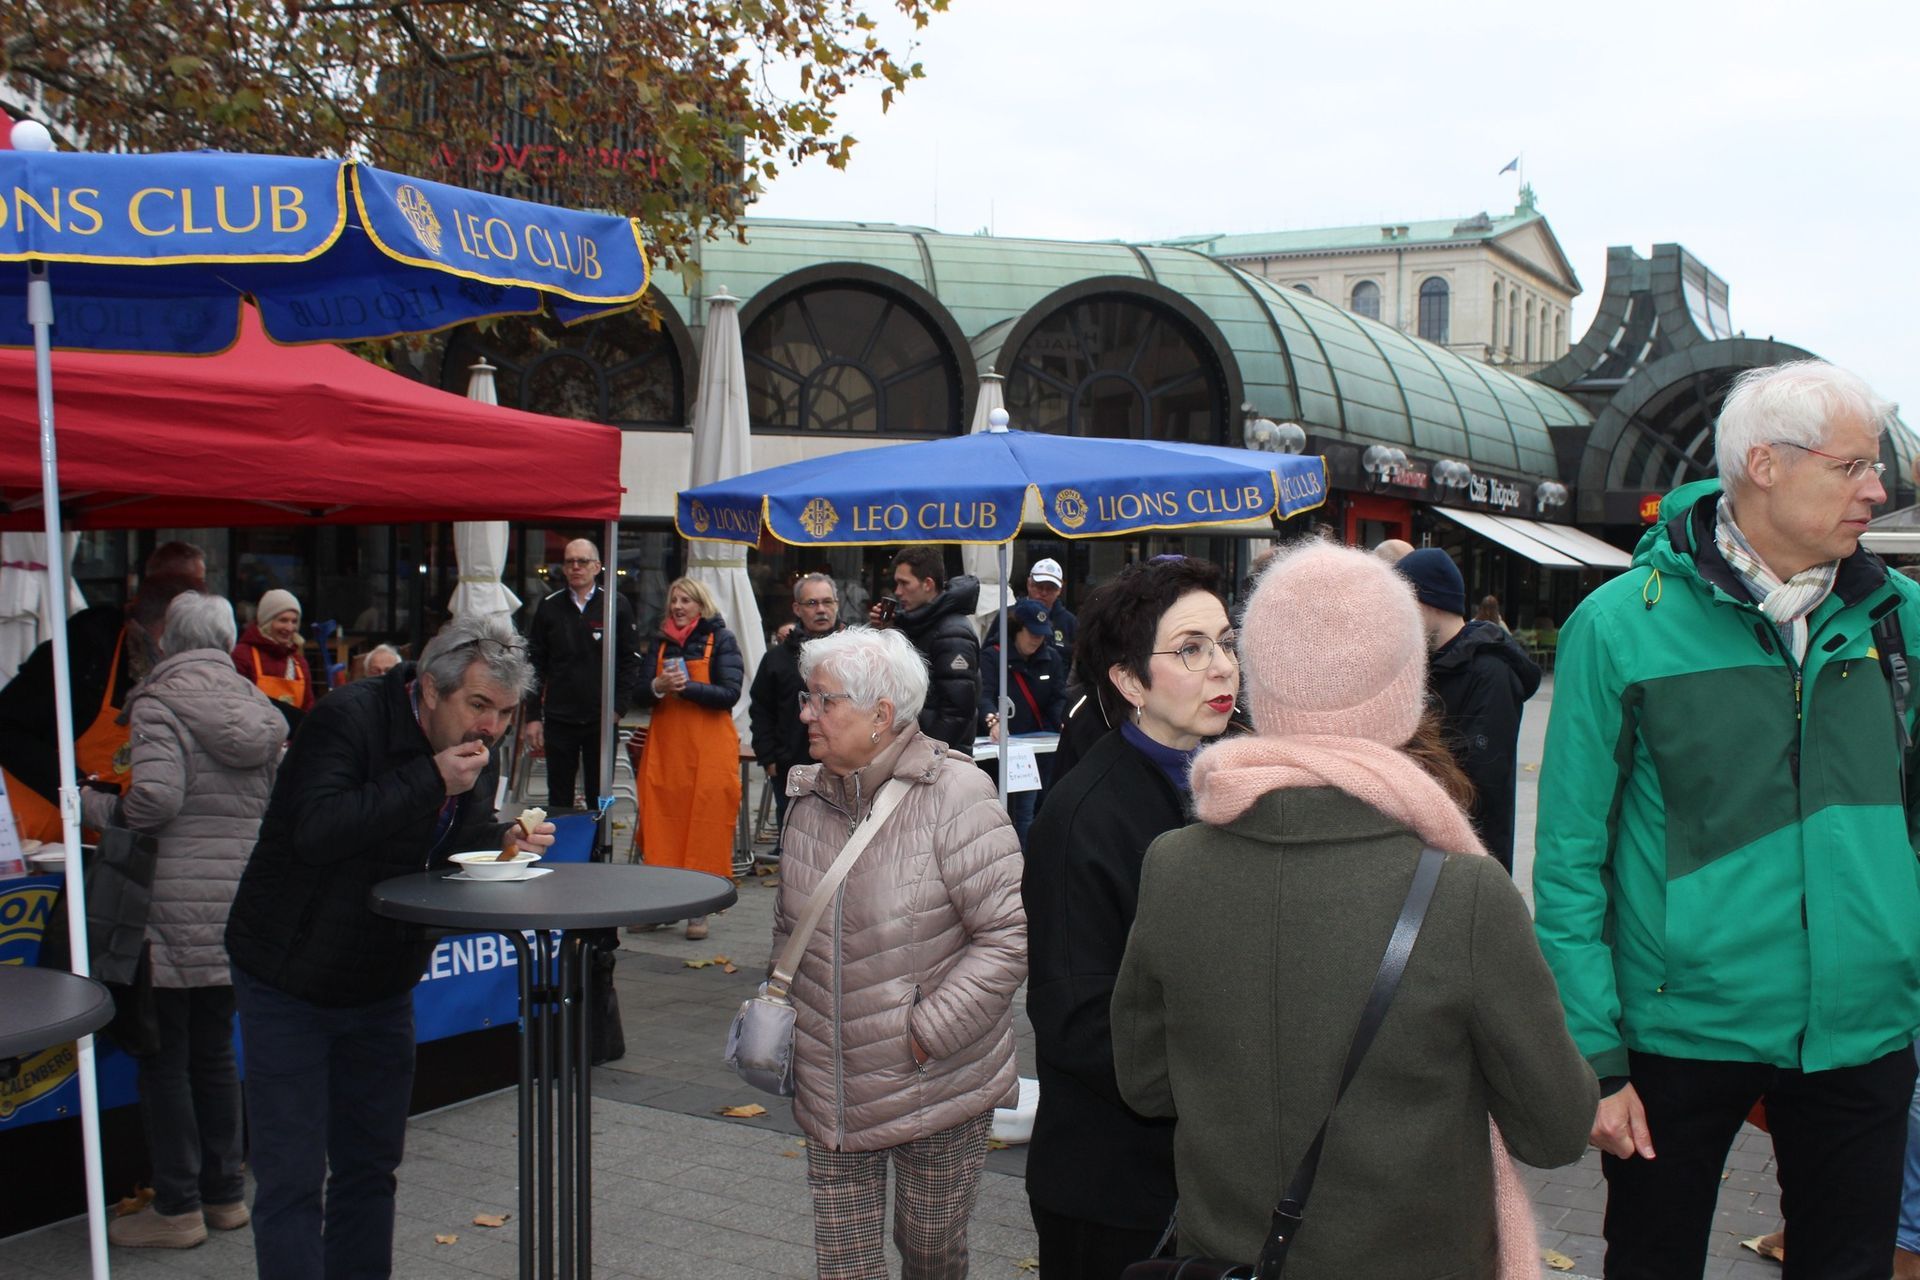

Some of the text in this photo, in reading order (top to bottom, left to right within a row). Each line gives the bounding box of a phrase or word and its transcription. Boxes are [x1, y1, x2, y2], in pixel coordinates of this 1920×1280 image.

[0, 185, 308, 237] NS CLUB
[453, 209, 603, 280] LEO CLUB
[1058, 489, 1080, 500] LIONS
[1064, 501, 1077, 515] L
[1098, 486, 1263, 521] LIONS CLUB
[853, 502, 998, 531] LEO CLUB
